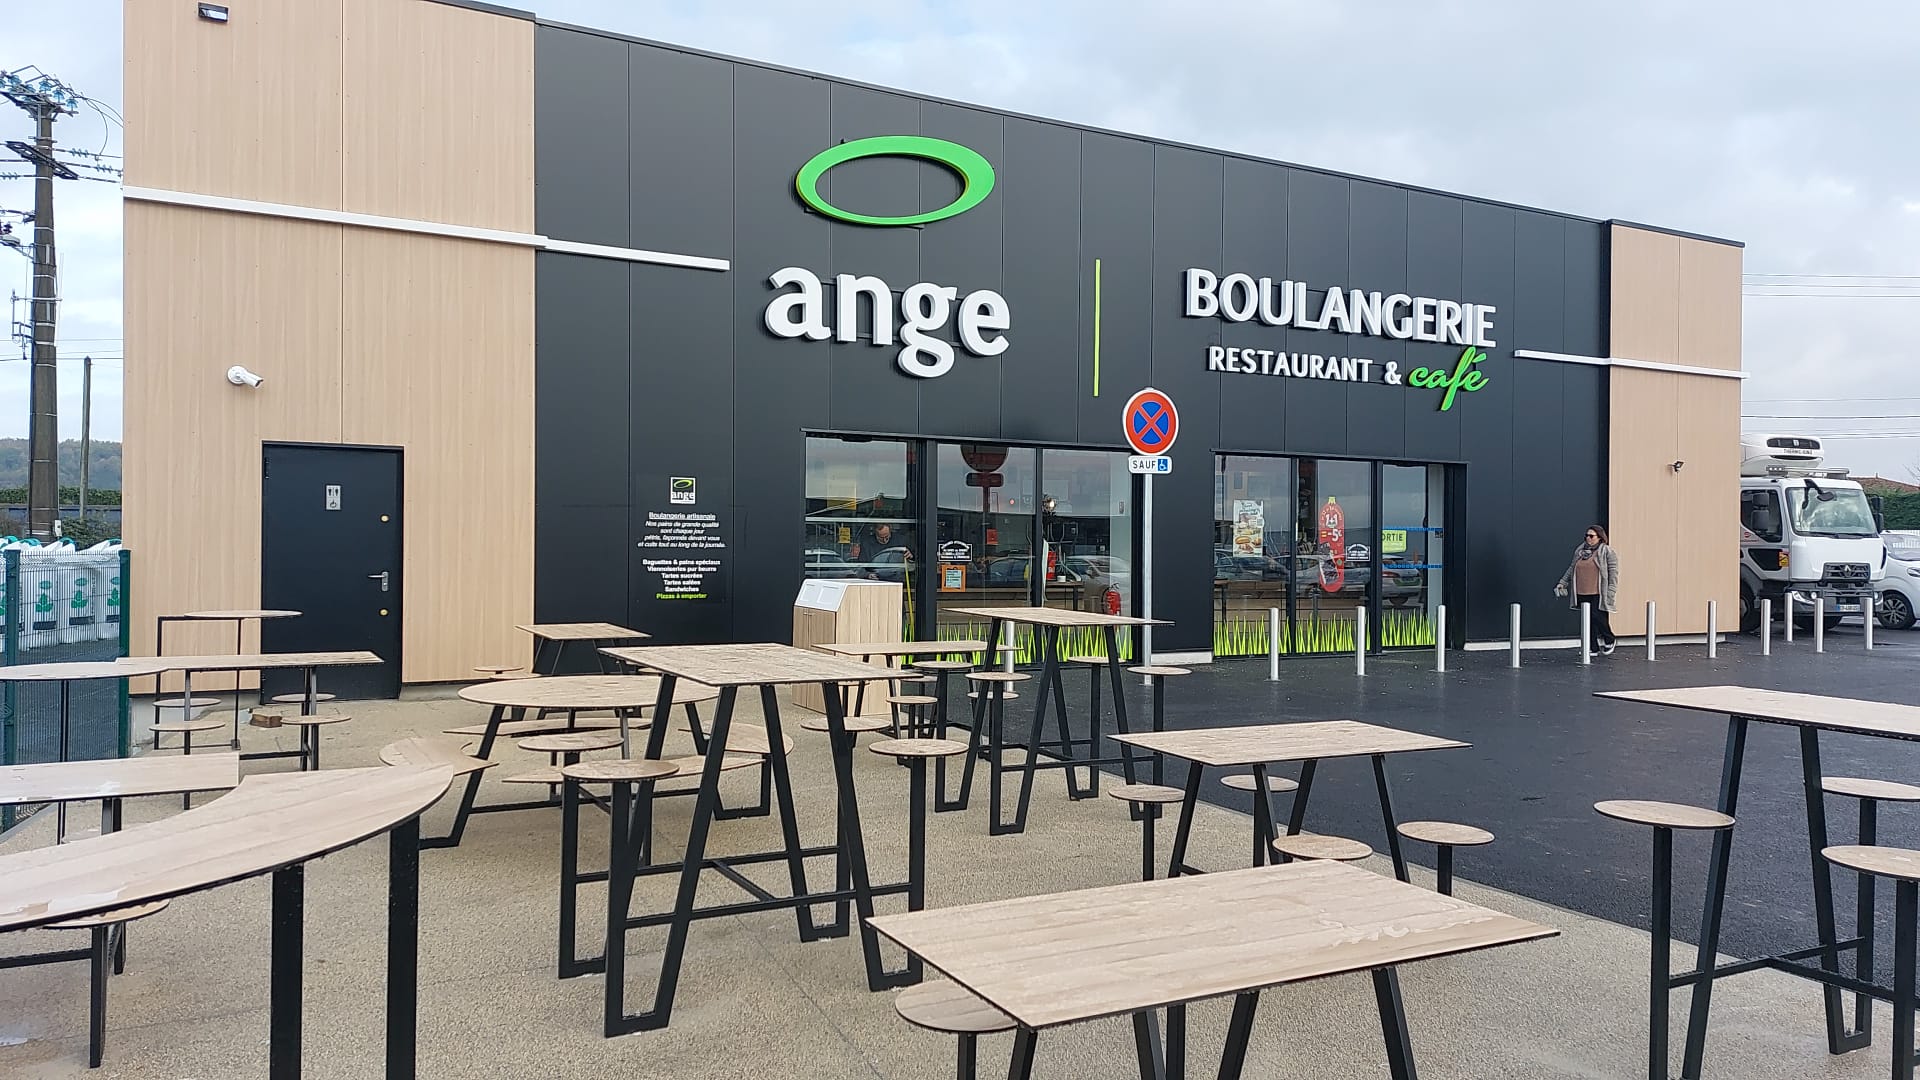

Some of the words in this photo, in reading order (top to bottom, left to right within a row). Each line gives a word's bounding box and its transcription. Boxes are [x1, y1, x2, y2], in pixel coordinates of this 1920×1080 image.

[765, 267, 1010, 378] ange
[1185, 268, 1497, 347] BOULANGERIE
[1208, 346, 1373, 382] RESTAURANT
[1384, 361, 1402, 385] &
[1408, 346, 1490, 411] café
[1132, 460, 1156, 469] SAUF
[671, 491, 695, 501] ange
[648, 512, 685, 520] Boulangerie
